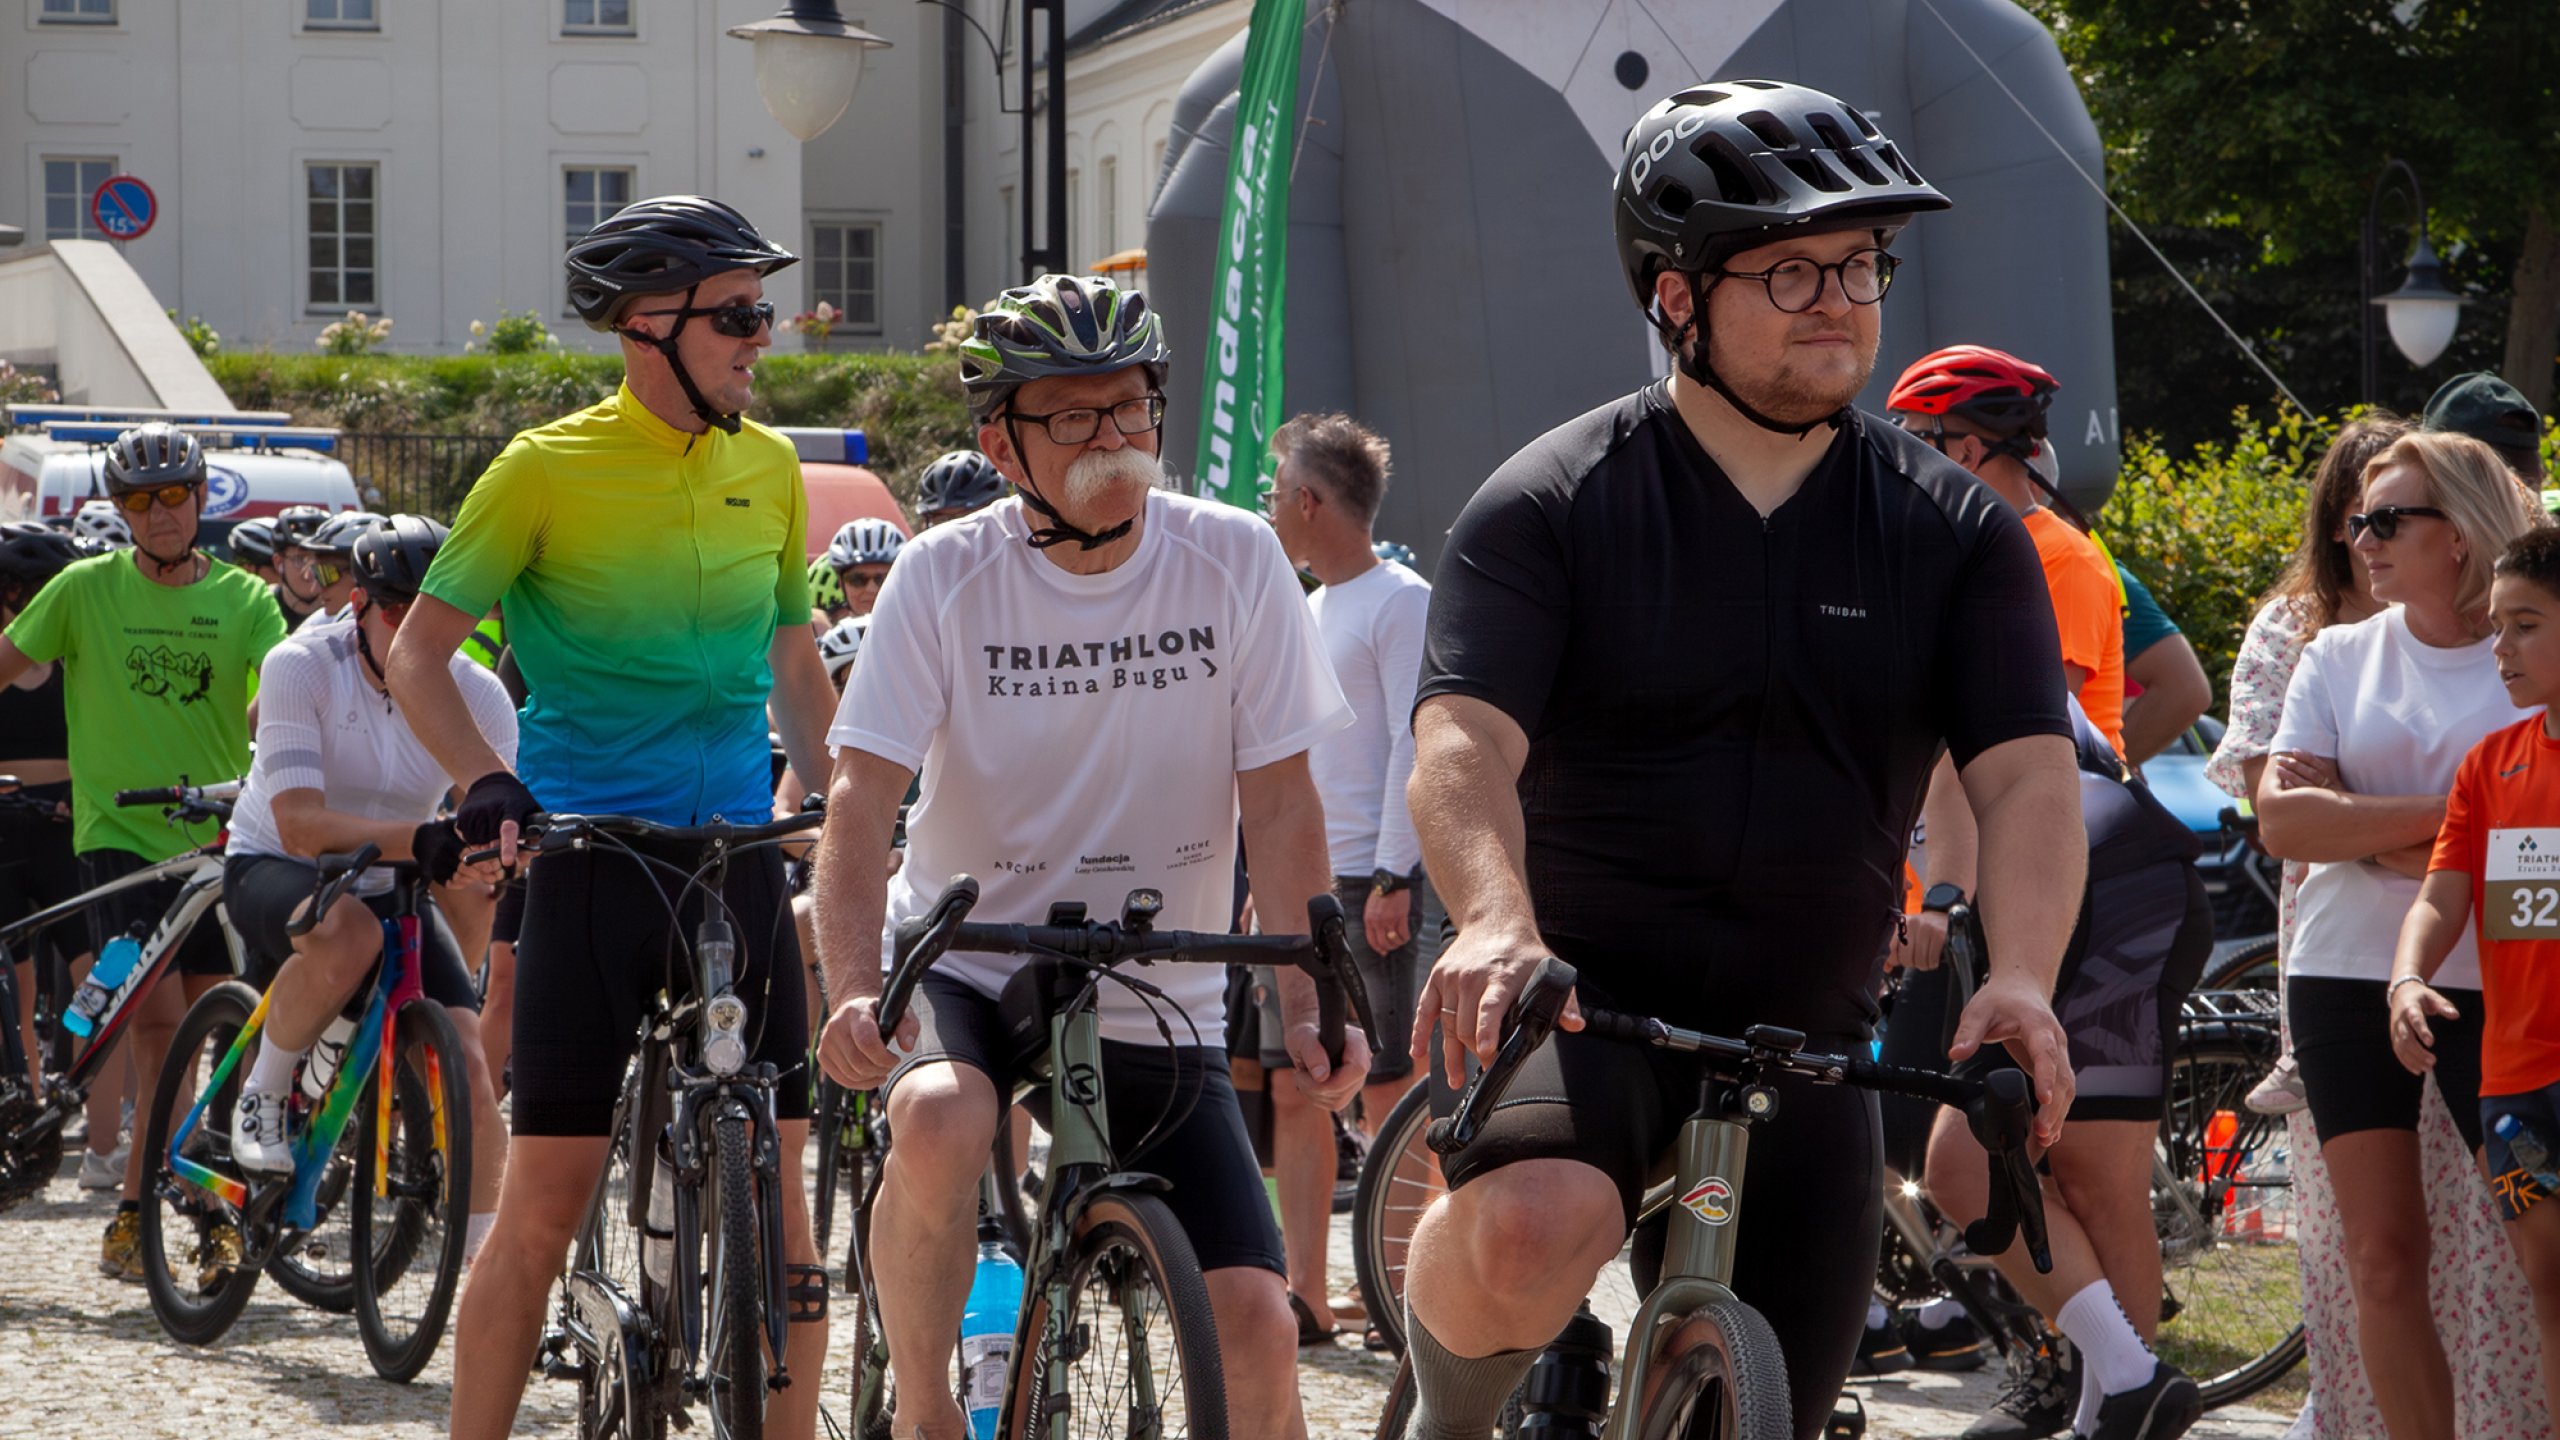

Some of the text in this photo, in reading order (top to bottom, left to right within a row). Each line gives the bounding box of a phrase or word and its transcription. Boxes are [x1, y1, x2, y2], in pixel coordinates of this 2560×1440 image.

[1820, 605, 1866, 618] TRIBAN
[984, 626, 1215, 671] TRIATHLON
[988, 666, 1188, 696] Kraina Bugu
[994, 861, 1046, 875] ARCHE
[1080, 854, 1130, 865] fundacja
[2510, 887, 2559, 928] 32
